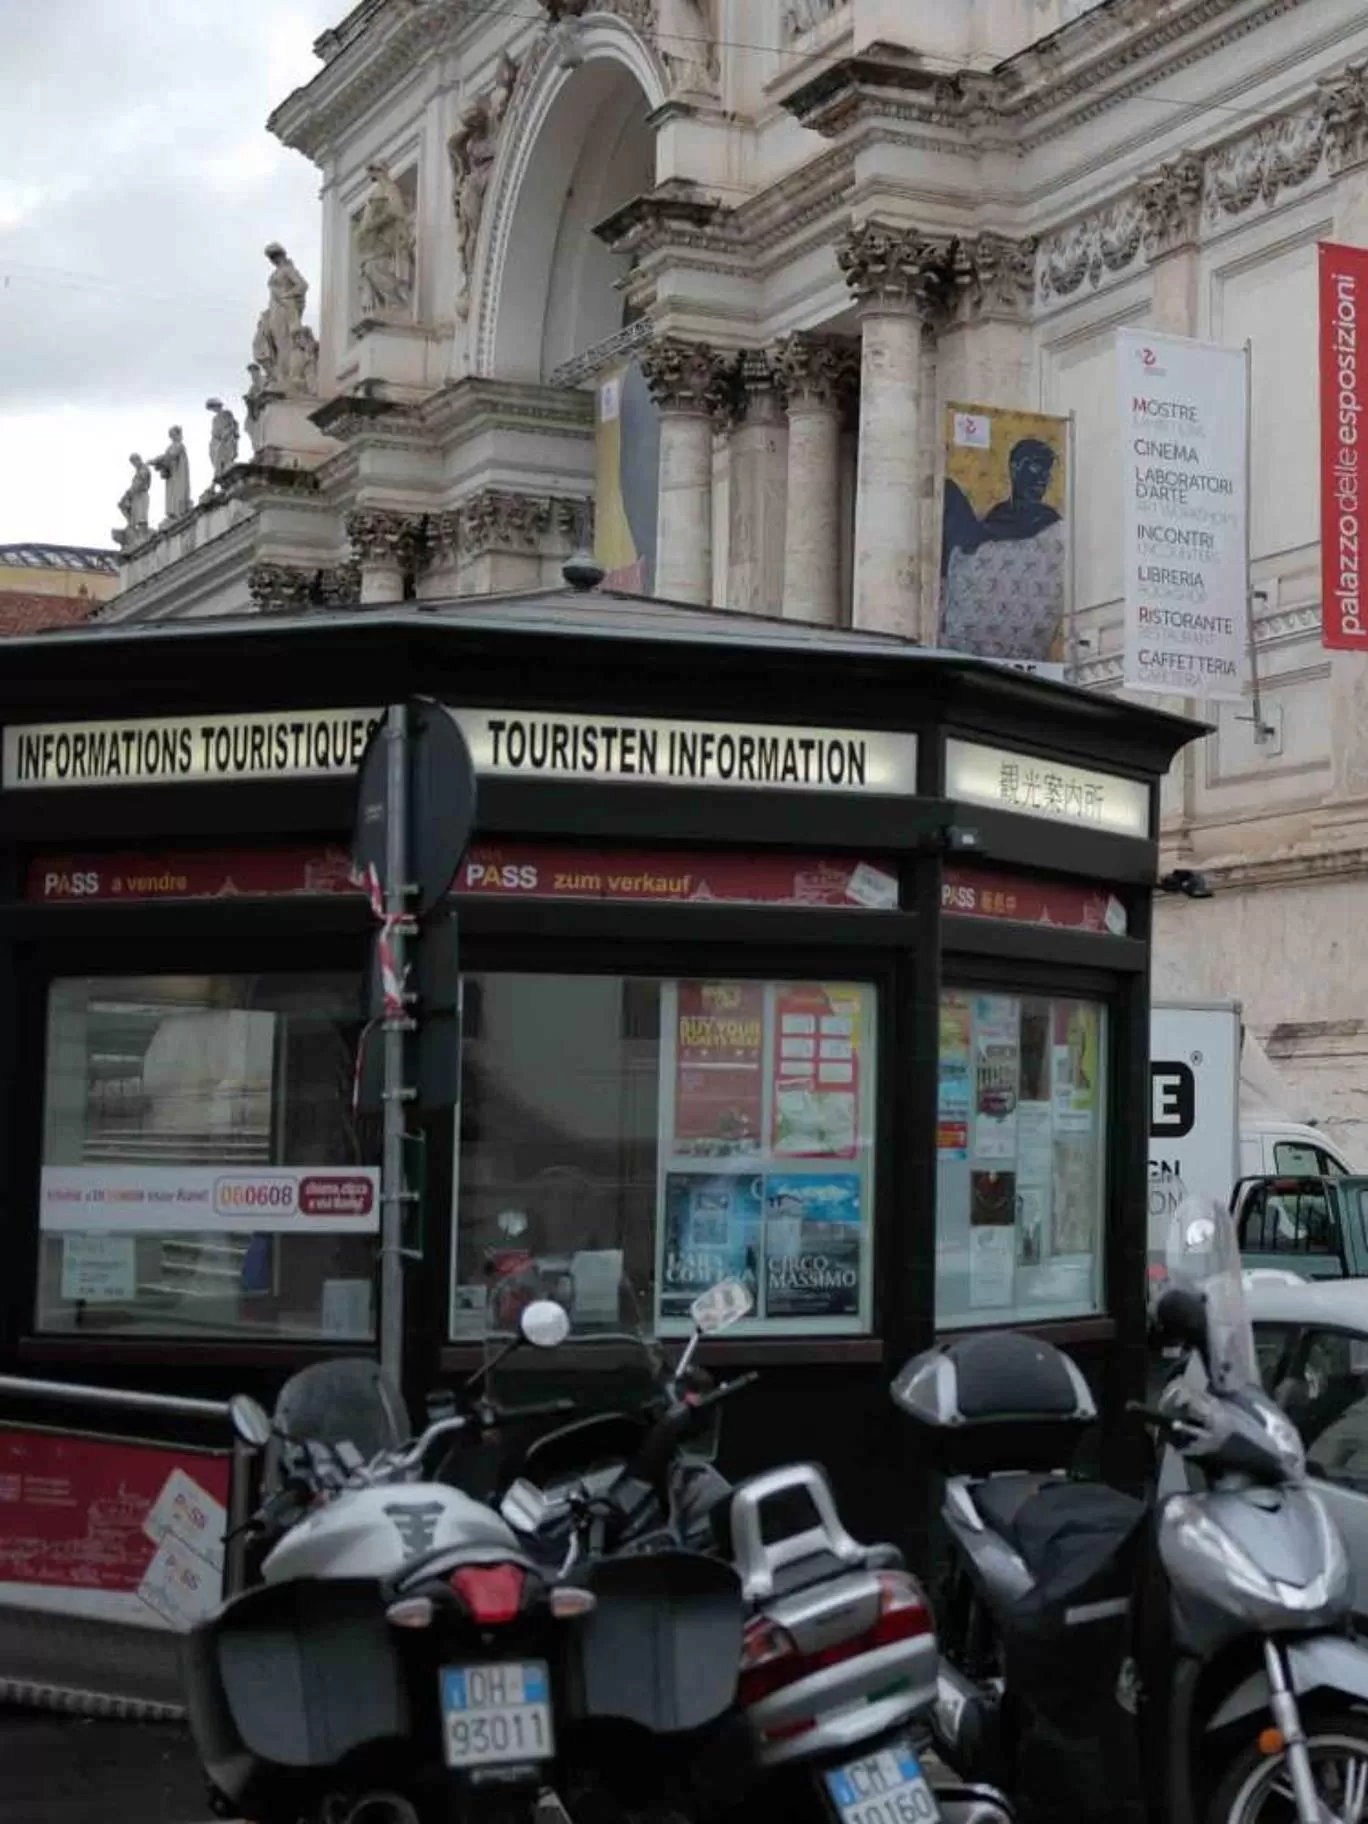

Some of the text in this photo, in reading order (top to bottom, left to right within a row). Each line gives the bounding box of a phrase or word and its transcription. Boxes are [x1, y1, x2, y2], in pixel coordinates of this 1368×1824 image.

[1132, 397, 1200, 423] MOSTRE
[1133, 437, 1200, 464] CINEMA
[1135, 465, 1234, 495] LABORATORI
[1137, 524, 1215, 549] INCONTRI
[1137, 565, 1205, 588] LIBRERIA
[1138, 606, 1233, 635] RISTORANTE
[1138, 649, 1237, 677] CAFFETTERIA
[17, 727, 192, 780] INFORMATIONS
[488, 720, 866, 786] TOURISTEN INFORMATION
[44, 872, 100, 896] PASS
[465, 864, 694, 894] PASS zum verkauf
[940, 883, 976, 909] PASS
[220, 1184, 293, 1206] 060608
[768, 1255, 829, 1273] CIRCO
[768, 1269, 858, 1290] MASSIMO
[451, 1711, 543, 1757] 93011
